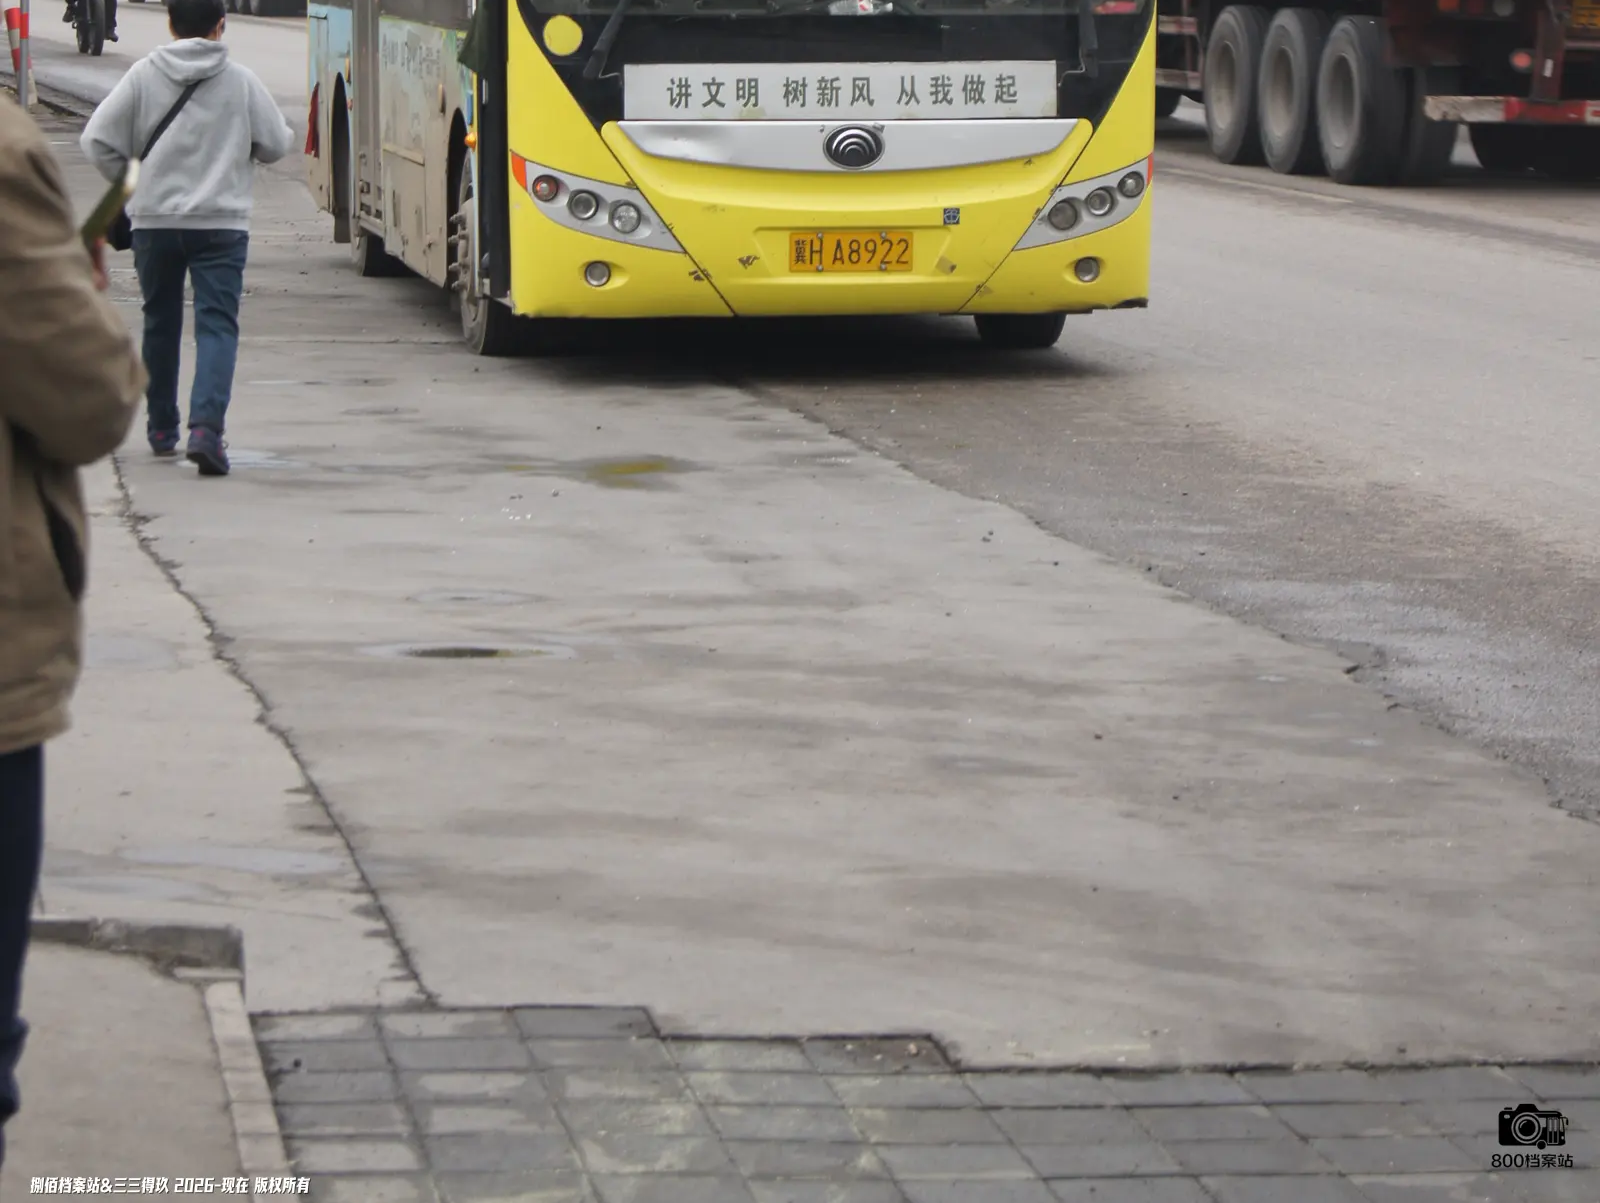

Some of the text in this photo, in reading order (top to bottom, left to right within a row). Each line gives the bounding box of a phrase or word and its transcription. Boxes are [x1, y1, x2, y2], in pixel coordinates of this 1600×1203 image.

[666, 73, 1018, 109] 讲文明 树新风 从我做起
